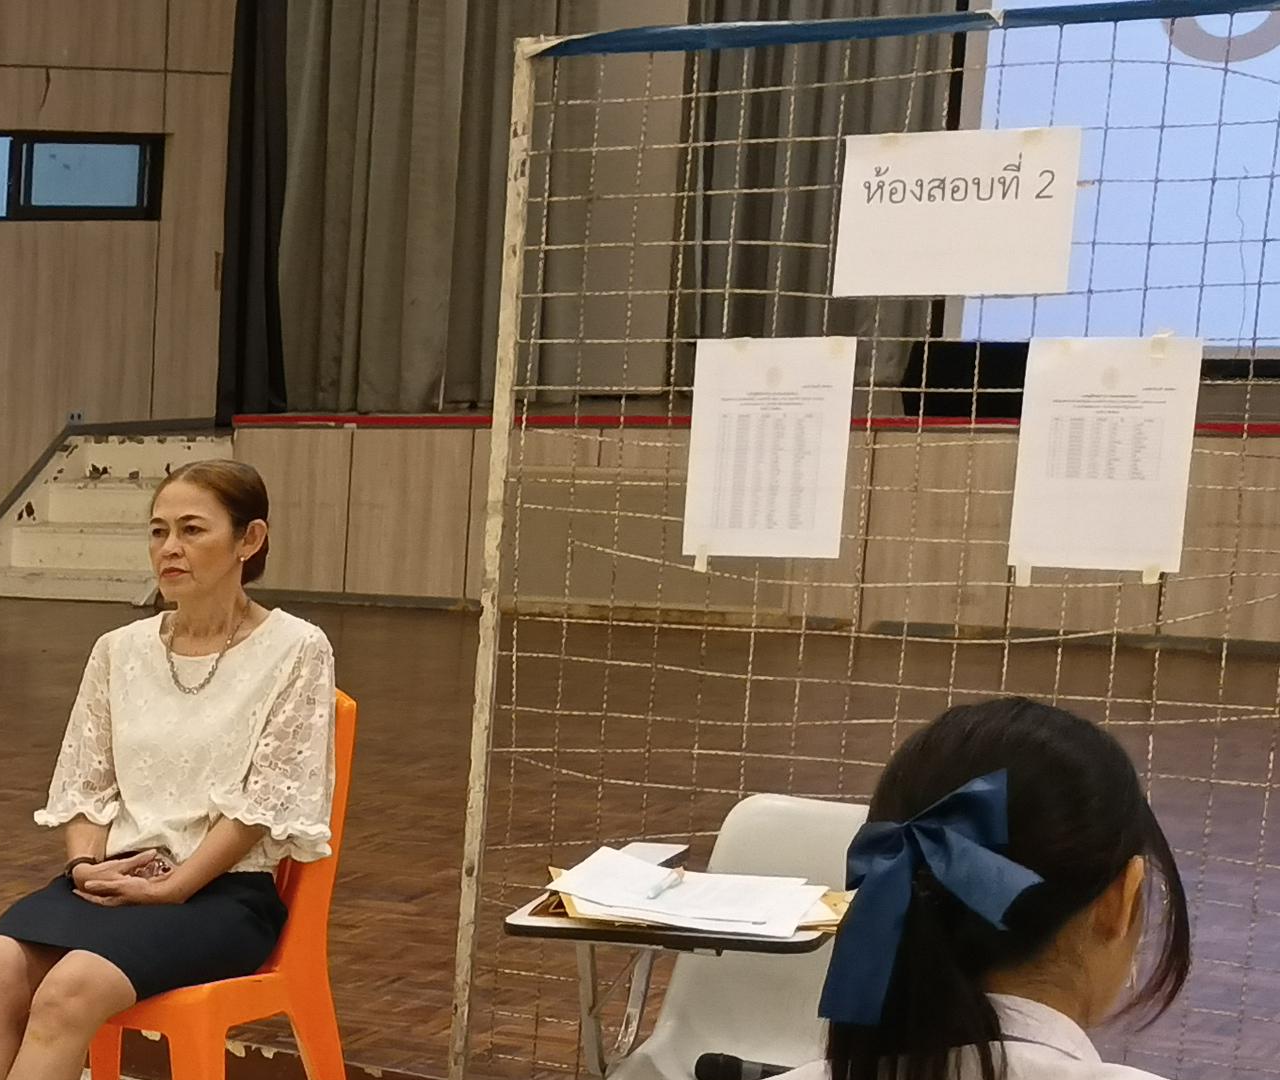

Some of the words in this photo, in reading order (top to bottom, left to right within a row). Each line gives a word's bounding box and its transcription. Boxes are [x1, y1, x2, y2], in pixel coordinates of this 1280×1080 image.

[863, 152, 1023, 204] ห้องสอบที่
[1034, 169, 1056, 200] 2
